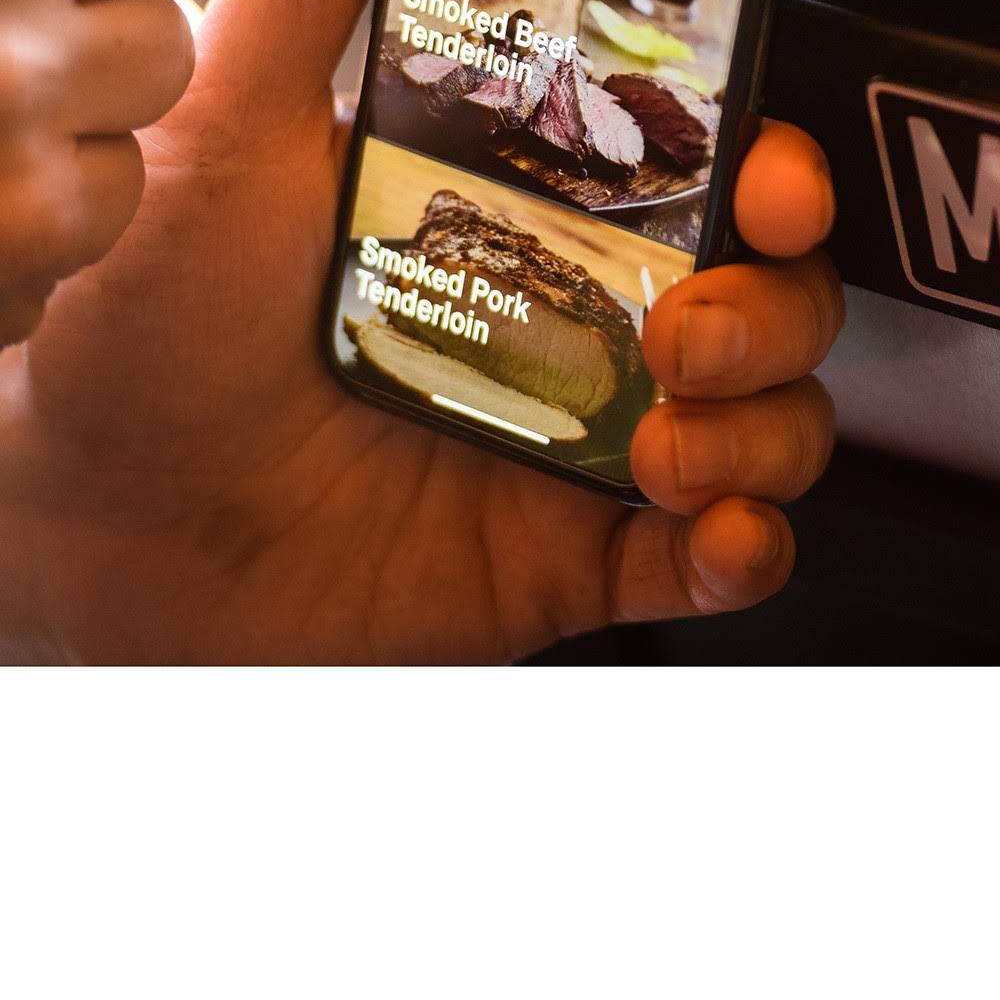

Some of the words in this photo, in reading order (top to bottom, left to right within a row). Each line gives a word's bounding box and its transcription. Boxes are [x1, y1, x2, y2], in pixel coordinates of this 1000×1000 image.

[399, 13, 533, 87] Tenderloin
[514, 17, 578, 64] Beef
[354, 267, 490, 345] Tenderloin
[358, 235, 465, 298] Smoked
[471, 275, 531, 324] Pork
